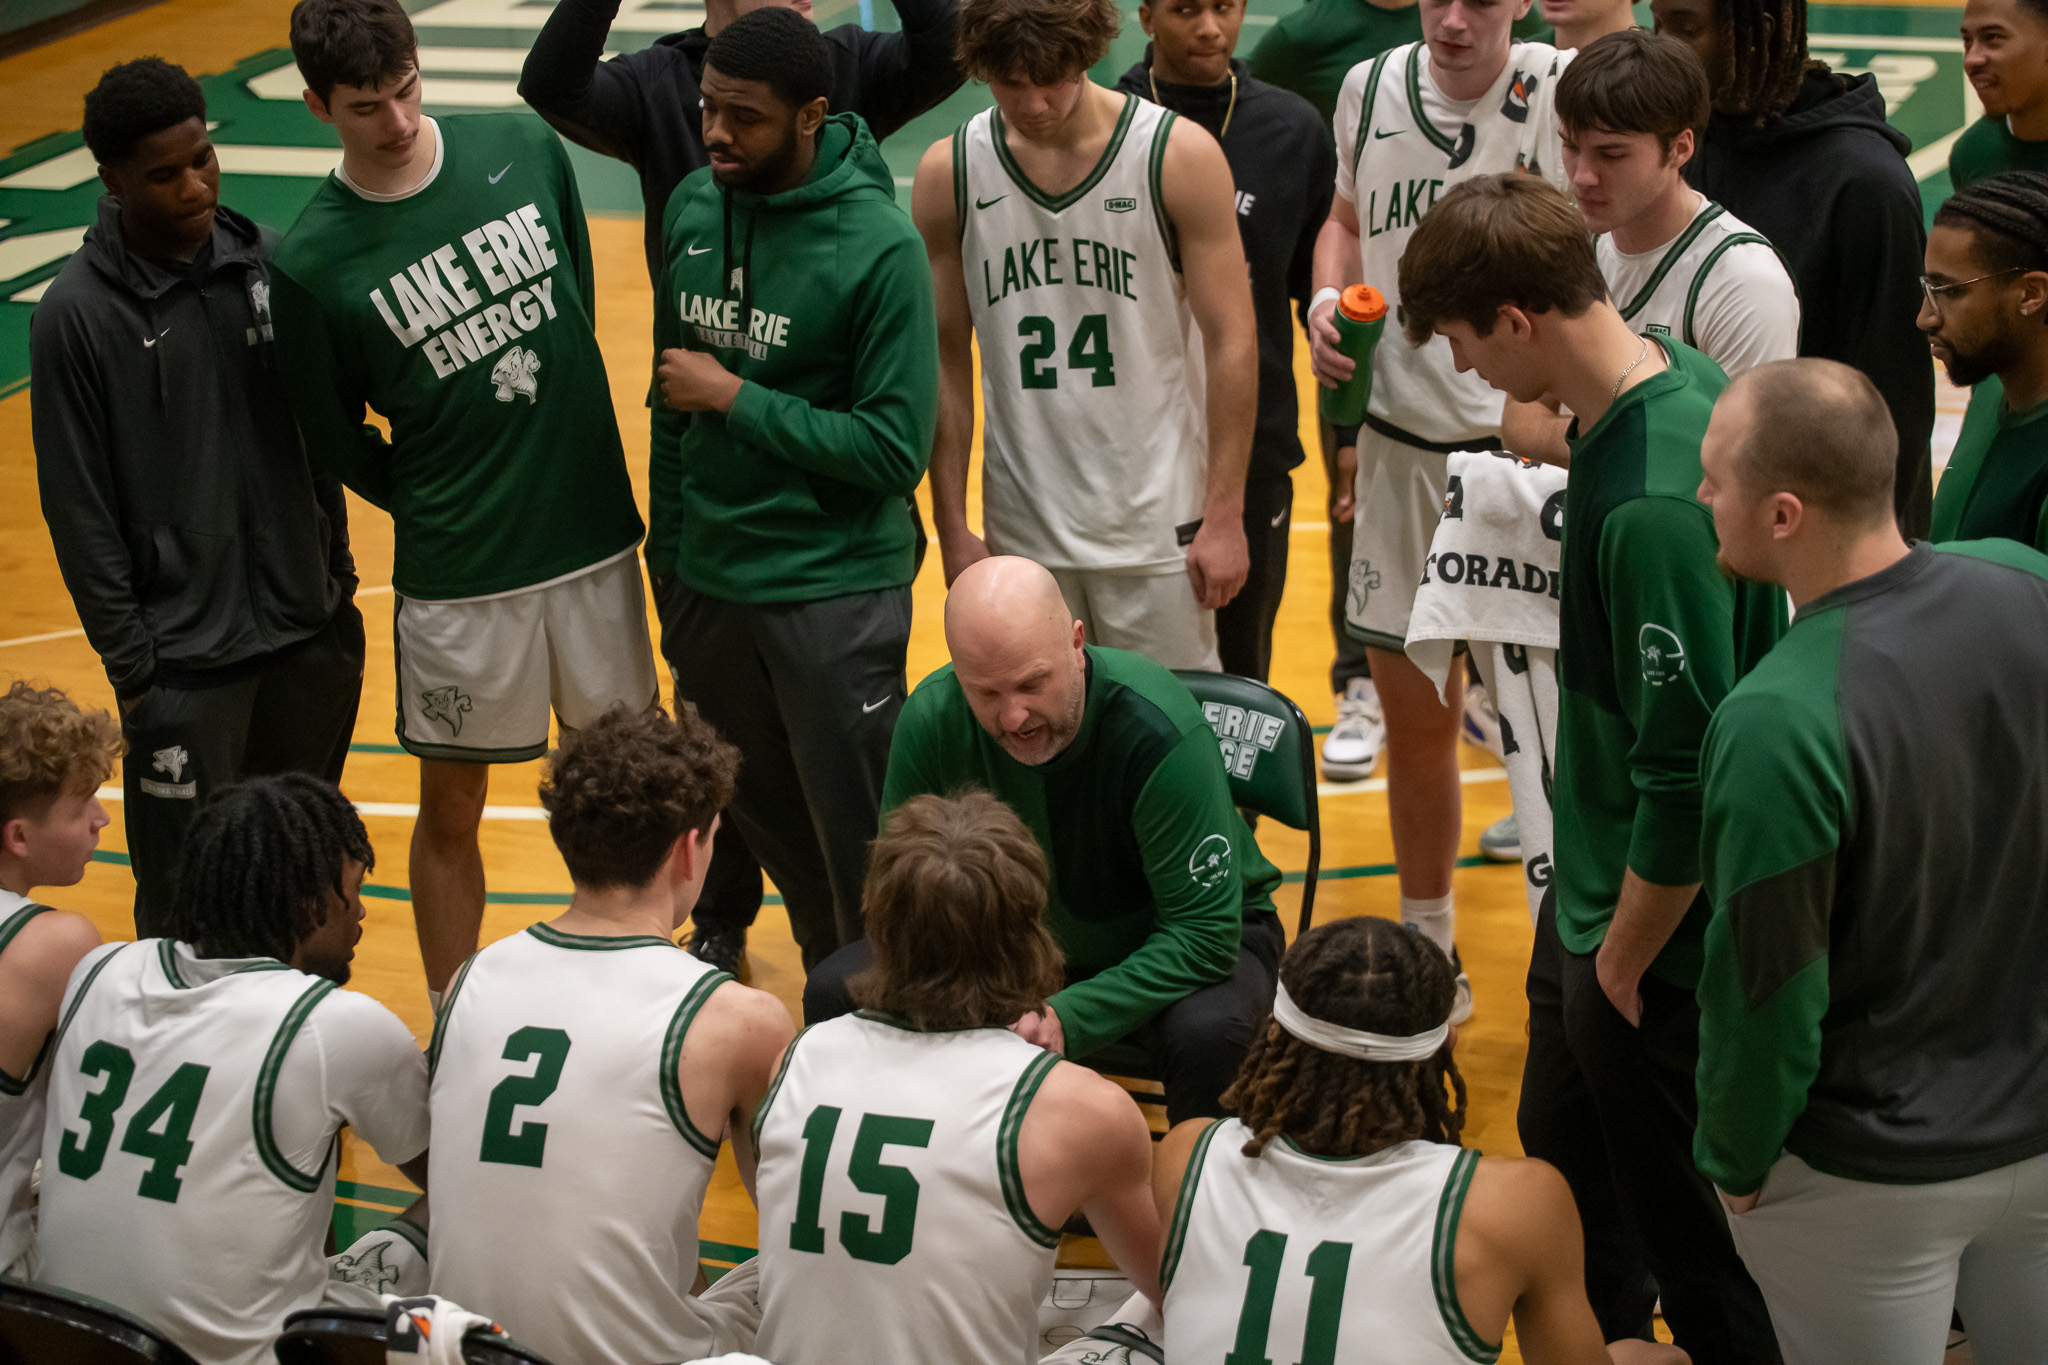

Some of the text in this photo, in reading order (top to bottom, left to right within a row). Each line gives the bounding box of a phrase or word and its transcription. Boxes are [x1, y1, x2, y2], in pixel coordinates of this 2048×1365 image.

[368, 202, 559, 349] LAKE ERIE
[421, 276, 558, 380] ENERGY
[680, 291, 791, 347] LAKE RIE
[984, 238, 1138, 308] LAKE ERIE
[1017, 313, 1116, 390] 24
[1202, 701, 1286, 753] ERIE
[57, 1038, 212, 1204] 34
[478, 1025, 573, 1169] 2
[788, 1103, 937, 1266] 15
[1223, 1227, 1354, 1365] 11
